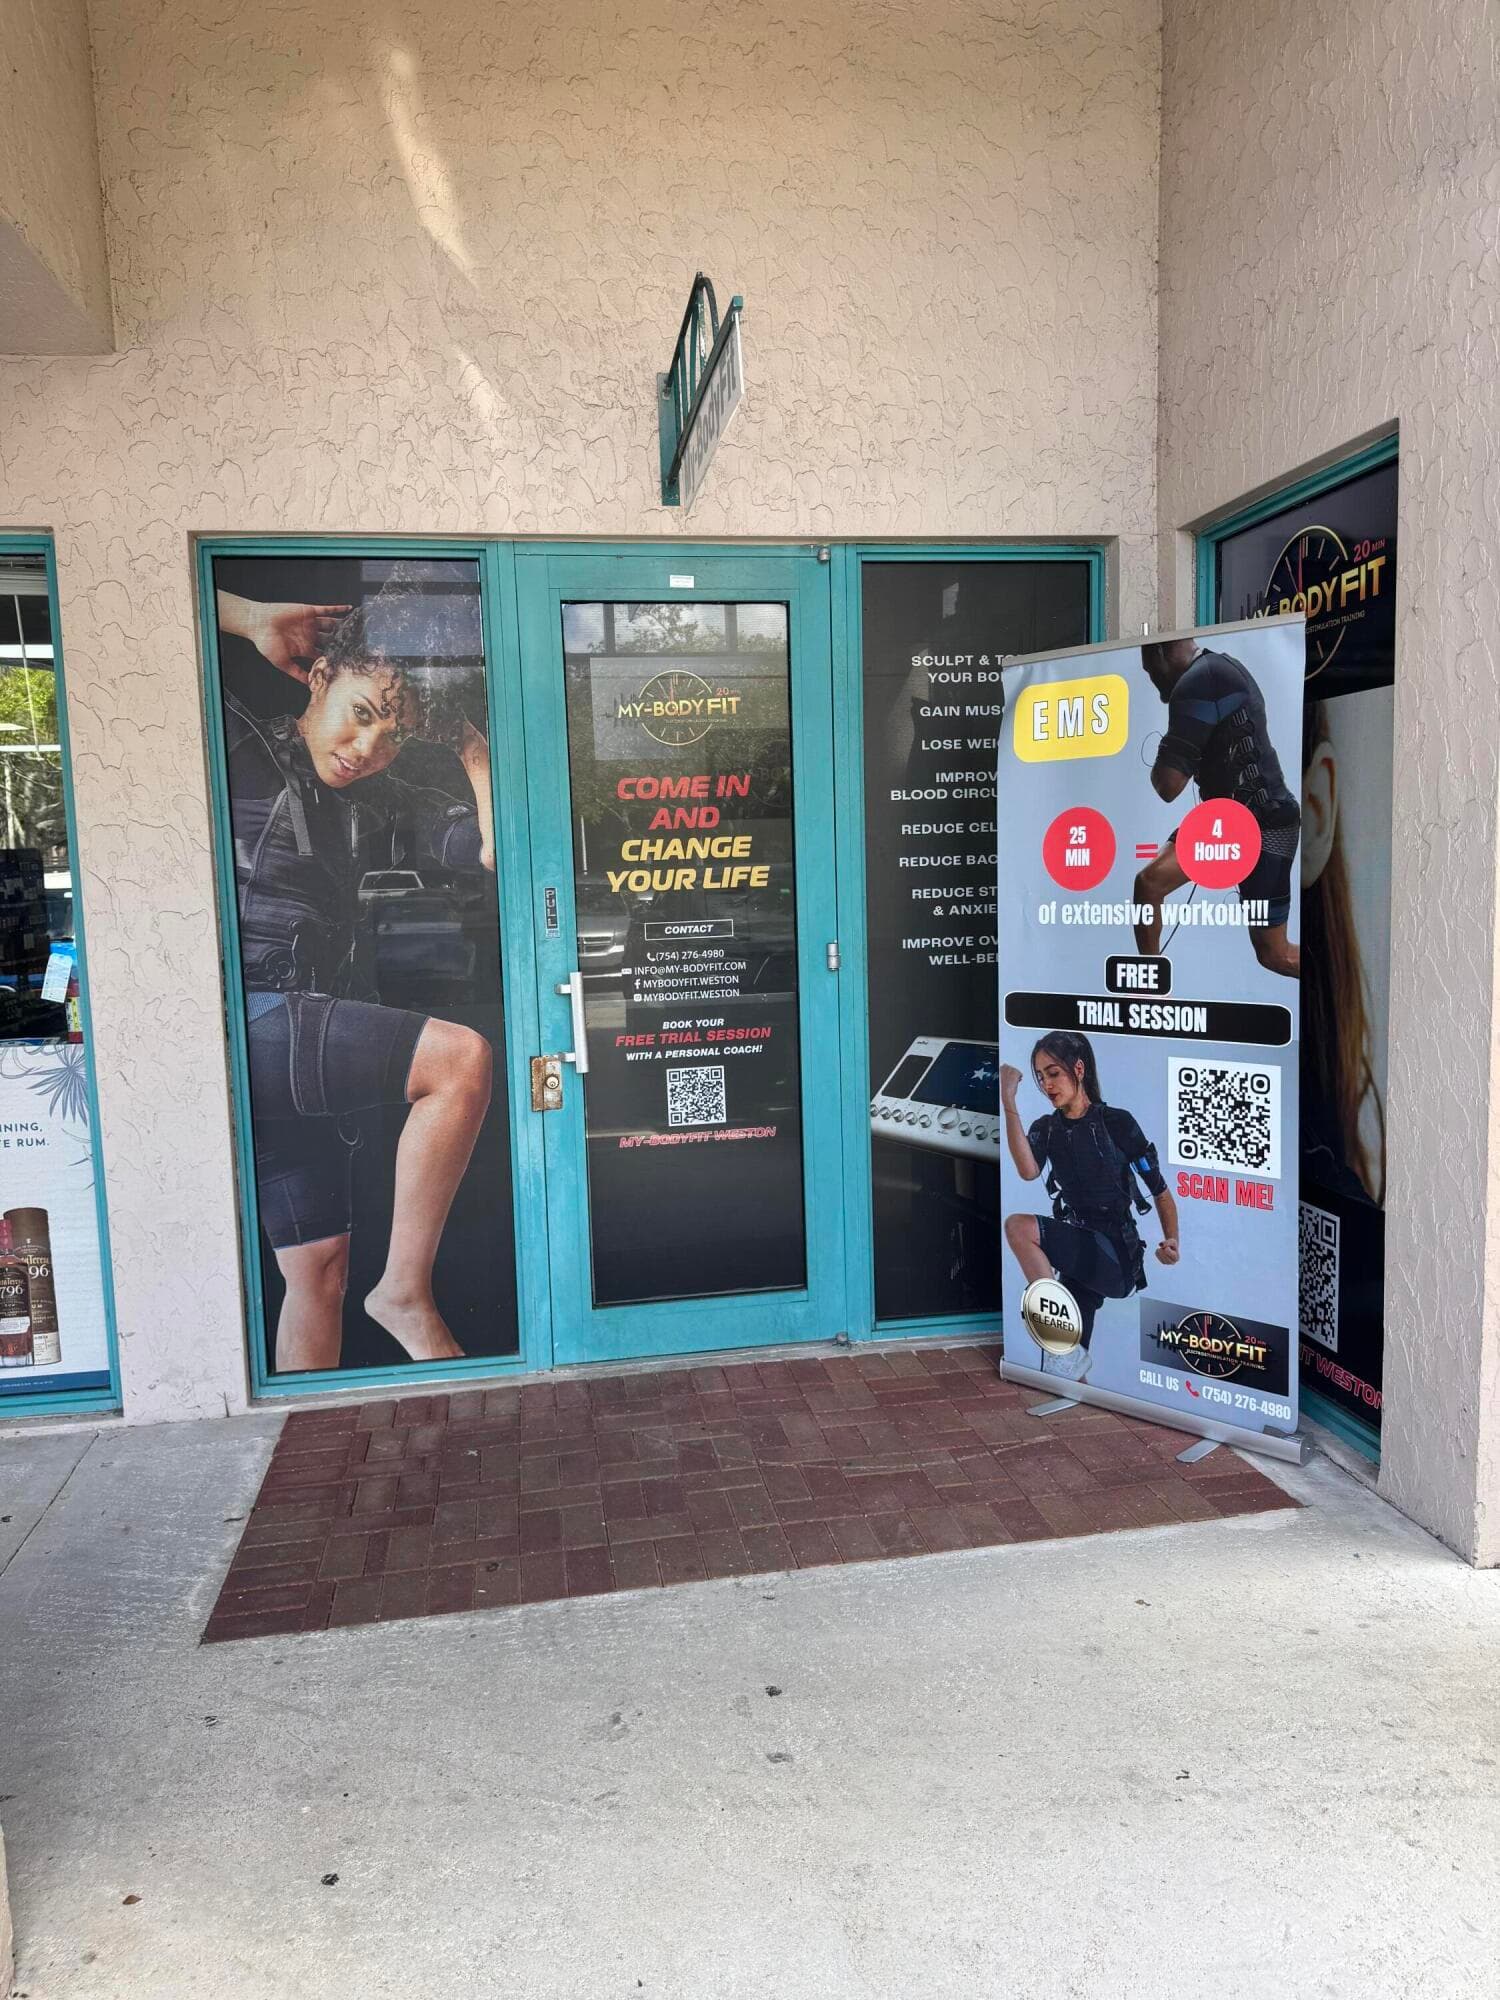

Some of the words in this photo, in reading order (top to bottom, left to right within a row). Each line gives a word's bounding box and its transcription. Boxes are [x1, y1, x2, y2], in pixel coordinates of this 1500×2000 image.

[1354, 540, 1370, 562] 20
[911, 655, 973, 666] SCULPT
[979, 655, 990, 665] &
[928, 672, 972, 683] YOUR
[977, 672, 1003, 682] BO
[920, 706, 960, 716] GAIN
[965, 705, 1004, 716] MUS
[922, 739, 962, 750] LOSE
[967, 738, 999, 749] WEI
[935, 771, 998, 782] IMPROV
[617, 776, 711, 800] COME
[716, 774, 751, 797] IN
[890, 789, 947, 800] BLOOD
[649, 806, 720, 830] AND
[901, 823, 964, 835] REDUCE
[1069, 826, 1087, 845] 25
[1212, 819, 1222, 838] 4
[621, 836, 752, 861] CHANGE
[1194, 841, 1241, 862] Hours
[899, 856, 962, 867] REDUCE
[966, 854, 998, 865] BAC
[1065, 848, 1090, 867] MIN
[606, 868, 696, 893] YOUR
[703, 865, 770, 889] LIFE
[912, 887, 974, 899] REDUCE
[546, 890, 557, 927] PULL
[933, 905, 944, 916] &
[949, 904, 997, 915] ANXIE
[1038, 900, 1057, 924] of
[1061, 901, 1154, 926] extensive
[1160, 899, 1269, 927] workout!!!
[664, 924, 714, 935] CONTACT
[902, 936, 974, 949] IMPROVE
[656, 951, 680, 961] (754)
[682, 950, 724, 960] 276-4980
[634, 961, 747, 975] INFO@MY-BODYFIT.COM
[643, 976, 739, 988] MYBODYFIT.WESTON
[1116, 963, 1158, 990] FREE
[644, 989, 740, 1002] MYBODYFIT.WESTON
[662, 1020, 692, 1030] BOOK
[696, 1018, 724, 1028] YOUR
[1077, 1000, 1123, 1027] TRIAL
[1128, 1003, 1207, 1033] SESSION
[616, 1034, 655, 1046] FREE
[659, 1031, 701, 1044] TRIAL
[706, 1027, 772, 1041] SESSION
[626, 1052, 652, 1061] WITH
[655, 1051, 662, 1059] A
[664, 1048, 720, 1058] PERSONAL
[724, 1045, 763, 1055] COACH!
[17, 1138, 50, 1147] RUM.
[619, 1130, 713, 1148] MY-BODYFIT
[715, 1127, 776, 1140] WESTON
[1176, 1171, 1230, 1203] SCAN
[1235, 1180, 1274, 1211] ME!
[29, 1264, 49, 1279] 96
[0, 1284, 23, 1299] 796
[1039, 1297, 1070, 1320] FDA
[1032, 1311, 1075, 1333] CLEARED
[1245, 1335, 1257, 1345] 20
[1139, 1369, 1163, 1388] CALL
[1165, 1375, 1180, 1392] US
[1201, 1384, 1232, 1406] (754)
[1234, 1392, 1291, 1420] 276-4980
